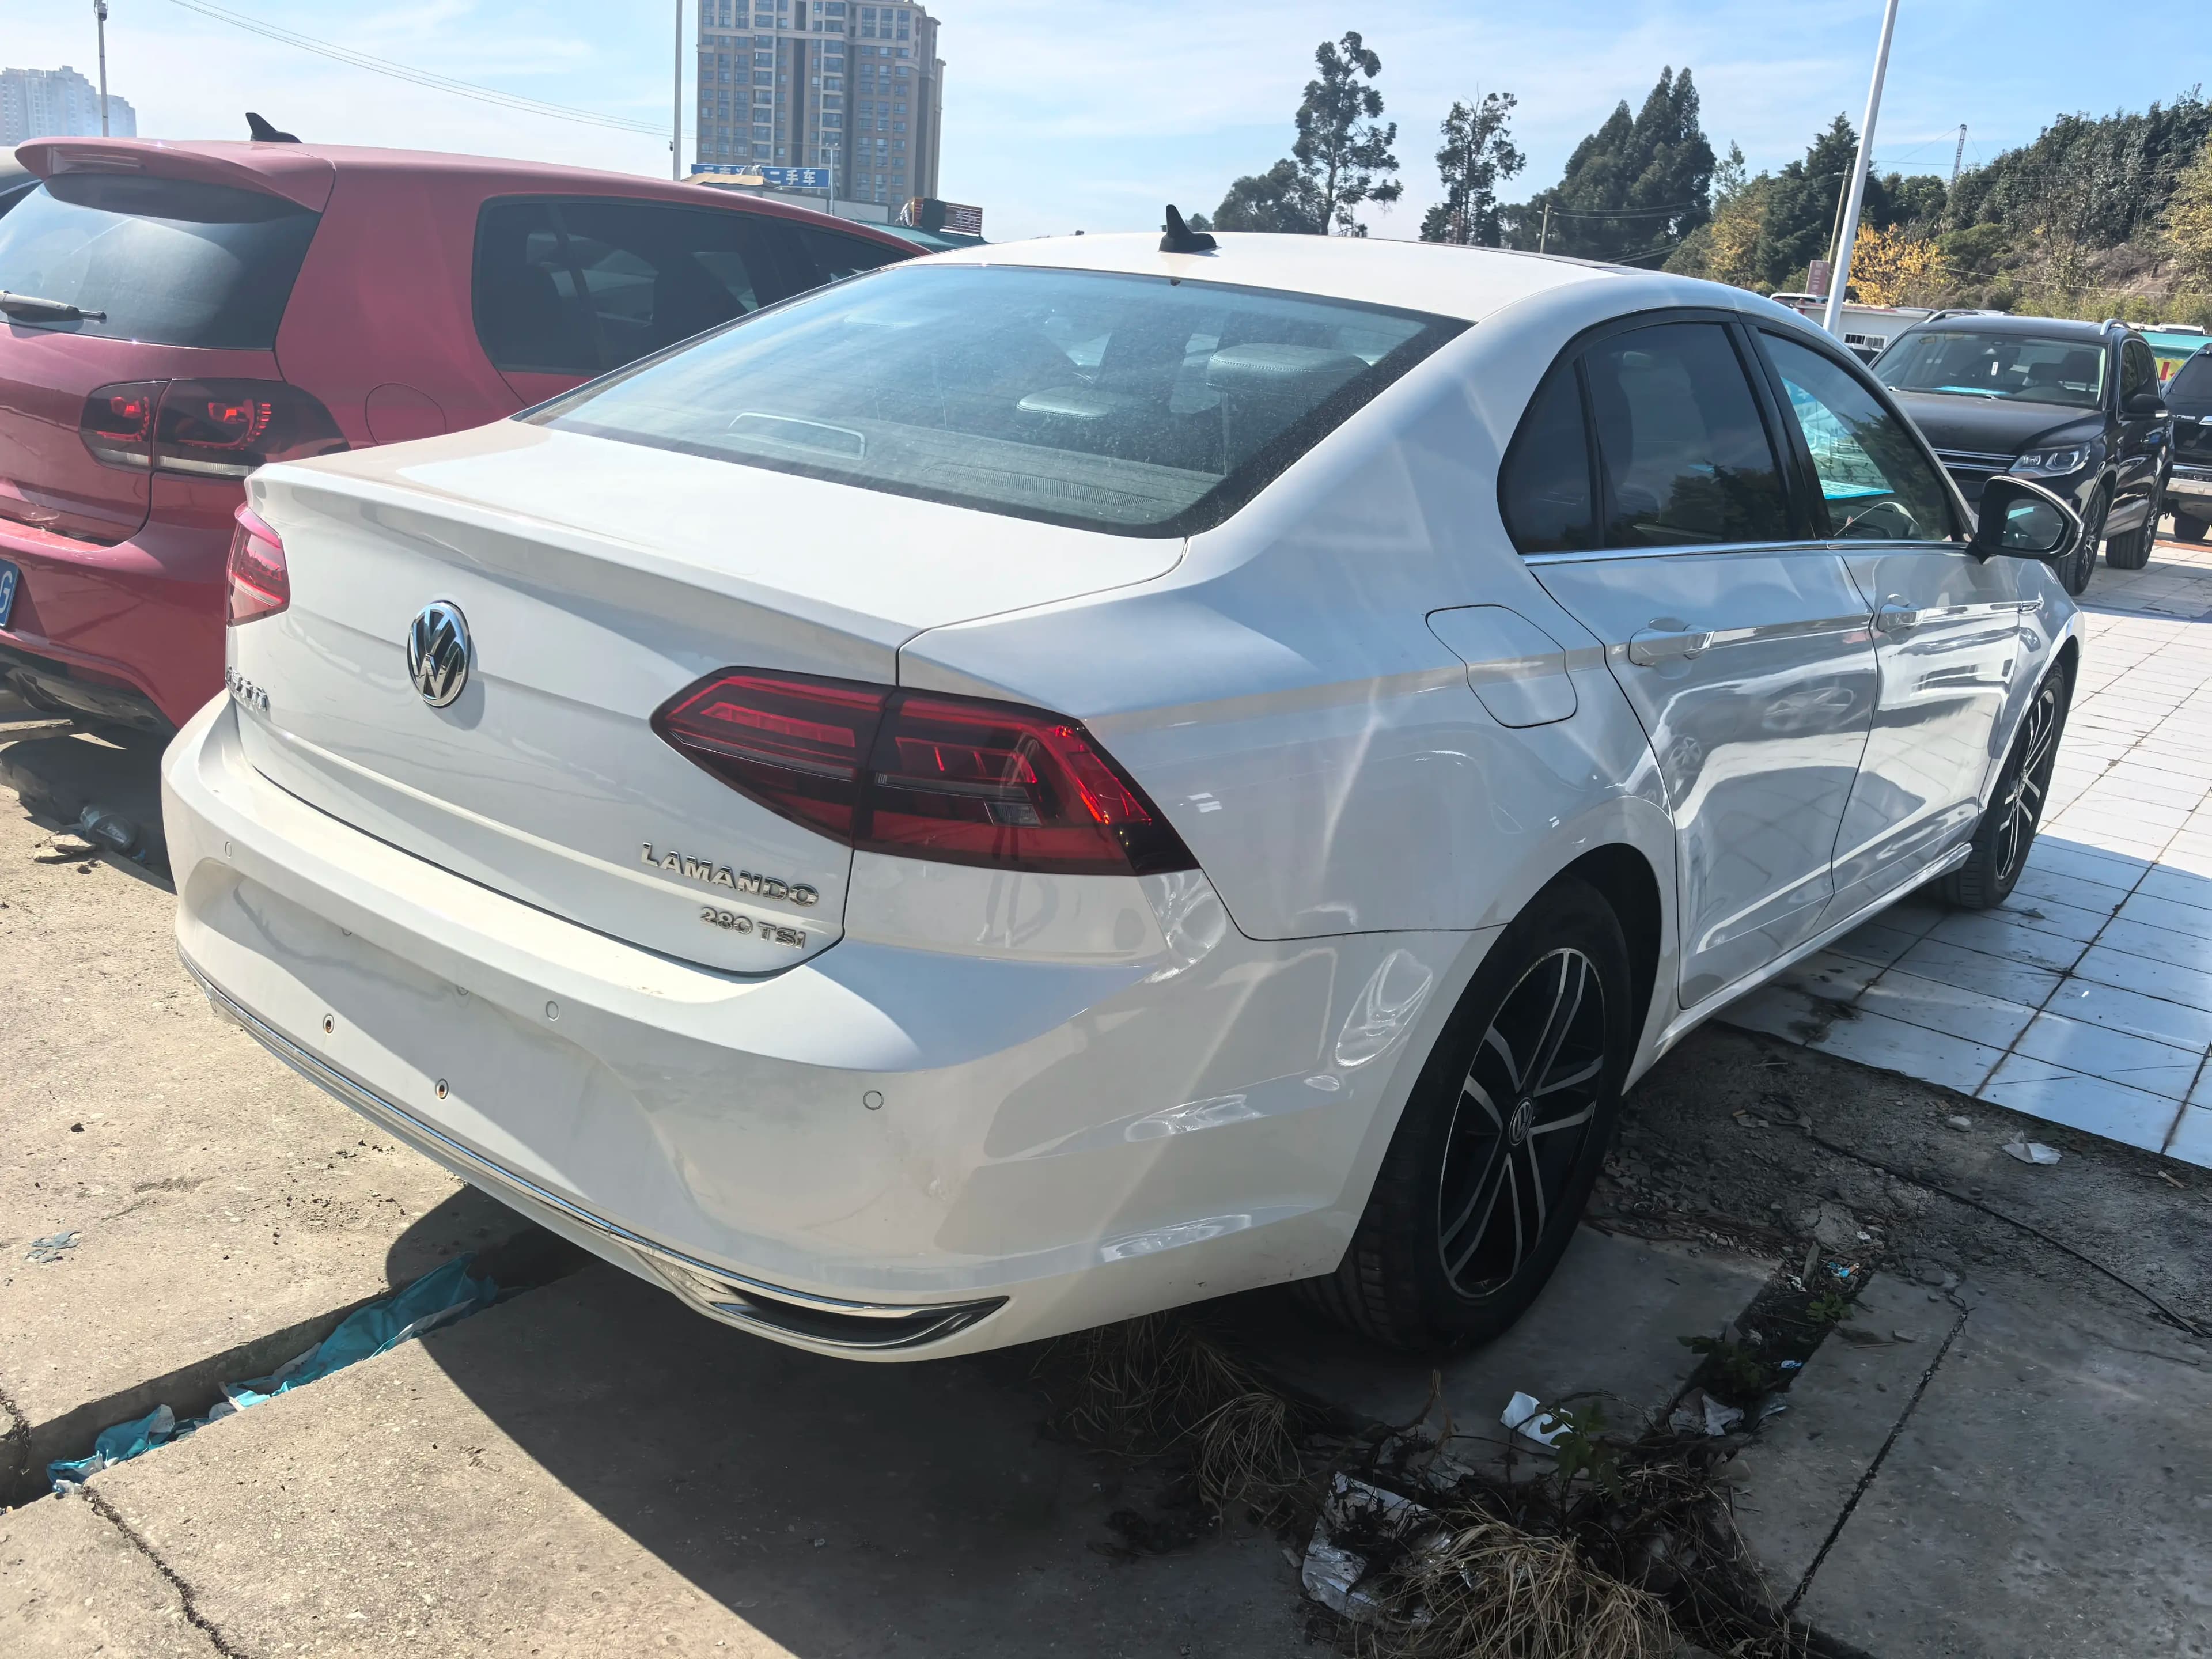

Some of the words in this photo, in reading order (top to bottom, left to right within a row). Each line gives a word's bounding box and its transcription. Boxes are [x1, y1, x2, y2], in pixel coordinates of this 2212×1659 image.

[641, 842, 819, 907] LAMANDO
[700, 907, 753, 935] 280
[757, 921, 806, 949] TSI
